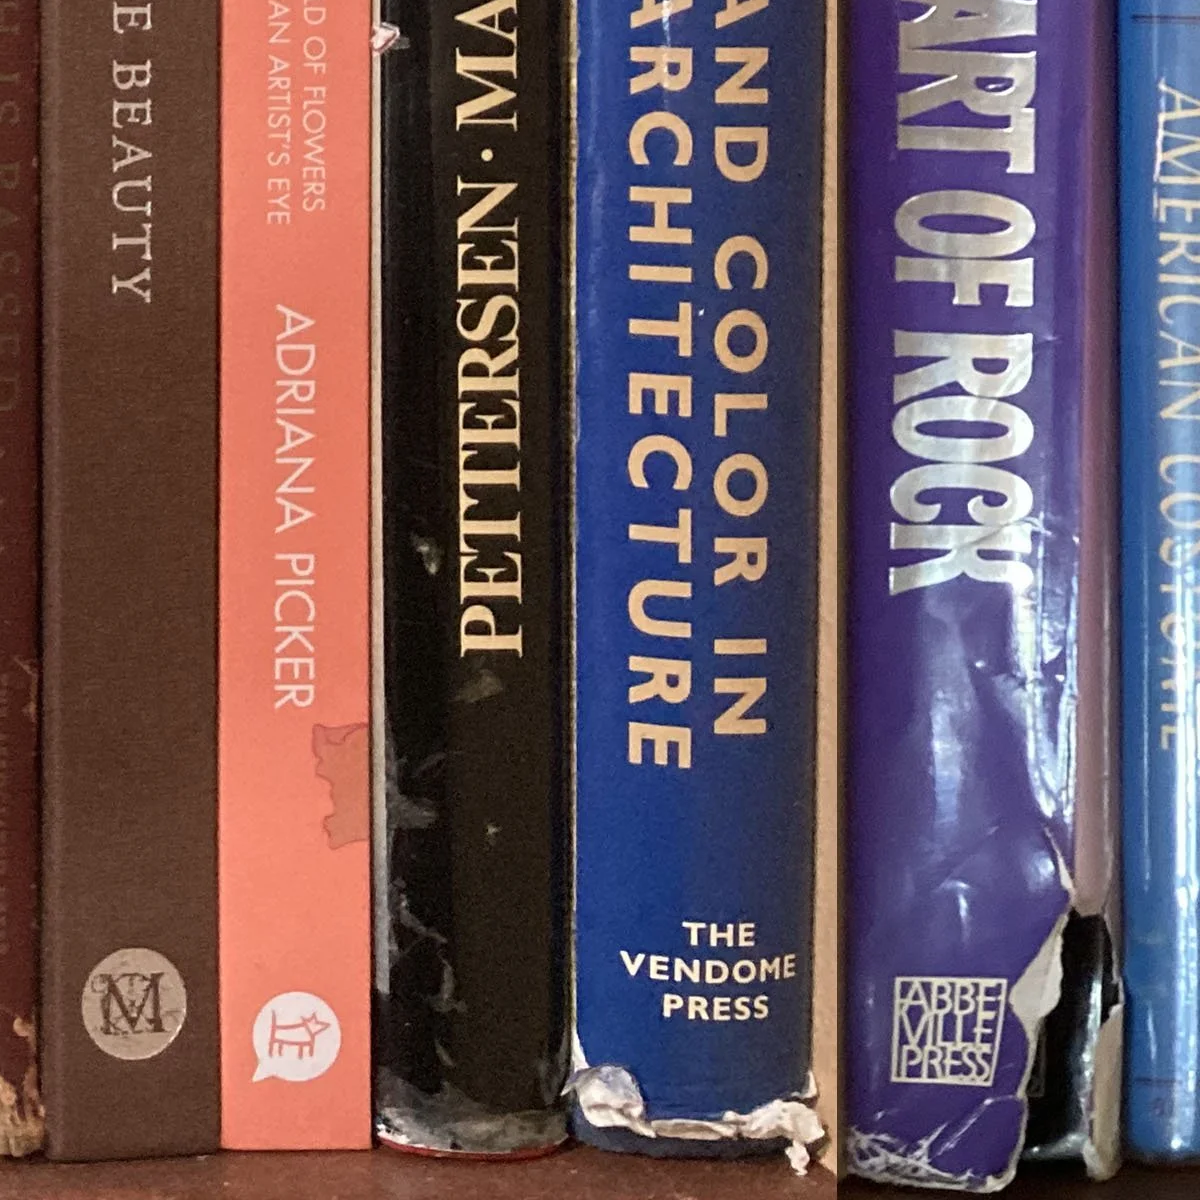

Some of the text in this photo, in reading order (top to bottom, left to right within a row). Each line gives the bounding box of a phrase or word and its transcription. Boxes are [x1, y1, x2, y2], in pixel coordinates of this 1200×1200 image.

[268, 0, 291, 44] AN
[303, 36, 327, 76] OF
[111, 59, 153, 302] BEAUTY
[302, 86, 326, 211] FLOWERS
[267, 179, 291, 225] EYE
[893, 190, 1038, 306] OF
[456, 176, 522, 658] PETTERSEN
[713, 235, 769, 586] COLOR
[274, 304, 316, 709] ADRIANA PICKER
[888, 330, 1036, 594] ROCK
[713, 637, 767, 735] IN
[620, 950, 796, 983] VENDOME
[682, 922, 755, 947] THE
[663, 994, 769, 1021] PRESS
[902, 1045, 992, 1080] PRESS
